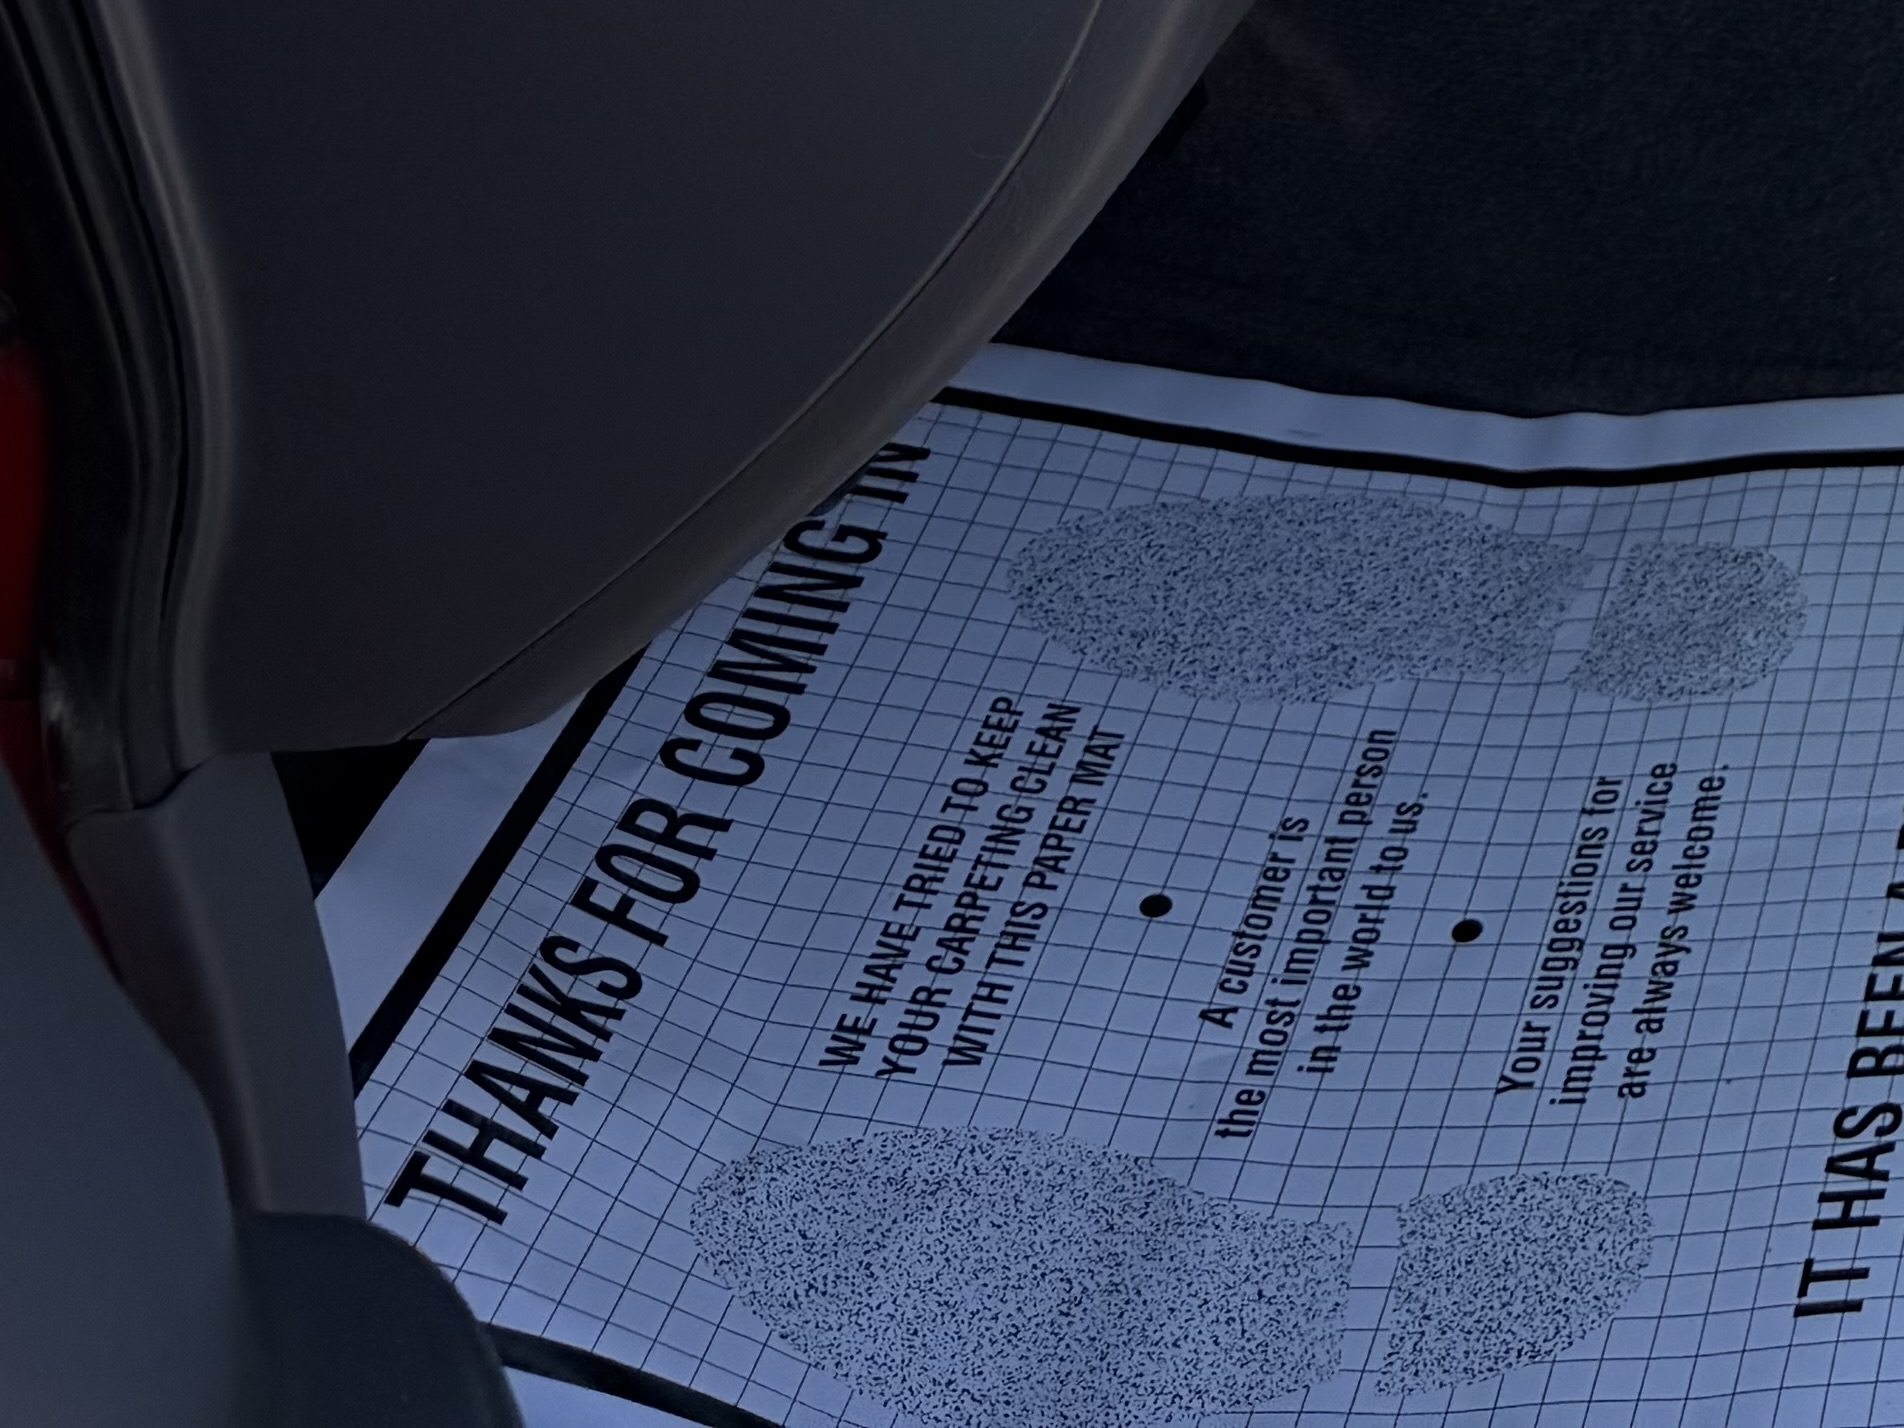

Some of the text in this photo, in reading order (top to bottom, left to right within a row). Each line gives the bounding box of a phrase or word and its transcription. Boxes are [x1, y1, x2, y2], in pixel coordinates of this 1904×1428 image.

[384, 935, 643, 1226] THANKS
[570, 797, 735, 947] FOR
[659, 519, 888, 787] COMING
[818, 696, 1024, 1066] WE HAVE TRIED TO KEEP
[874, 702, 1082, 1079] YOUR CARPETING CLEAN
[942, 725, 1126, 1066] WITH THIS PAPER MAT
[1198, 815, 1310, 1030] A customer is
[1214, 729, 1398, 1140] the most important person
[1296, 792, 1430, 1075] in the world to us.
[1494, 775, 1624, 1096] Your suggestions for
[1548, 762, 1678, 1107] improving our service
[1617, 763, 1730, 1100] are always welcome.
[1793, 1257, 1871, 1319] IT
[1811, 1101, 1904, 1232] HAS
